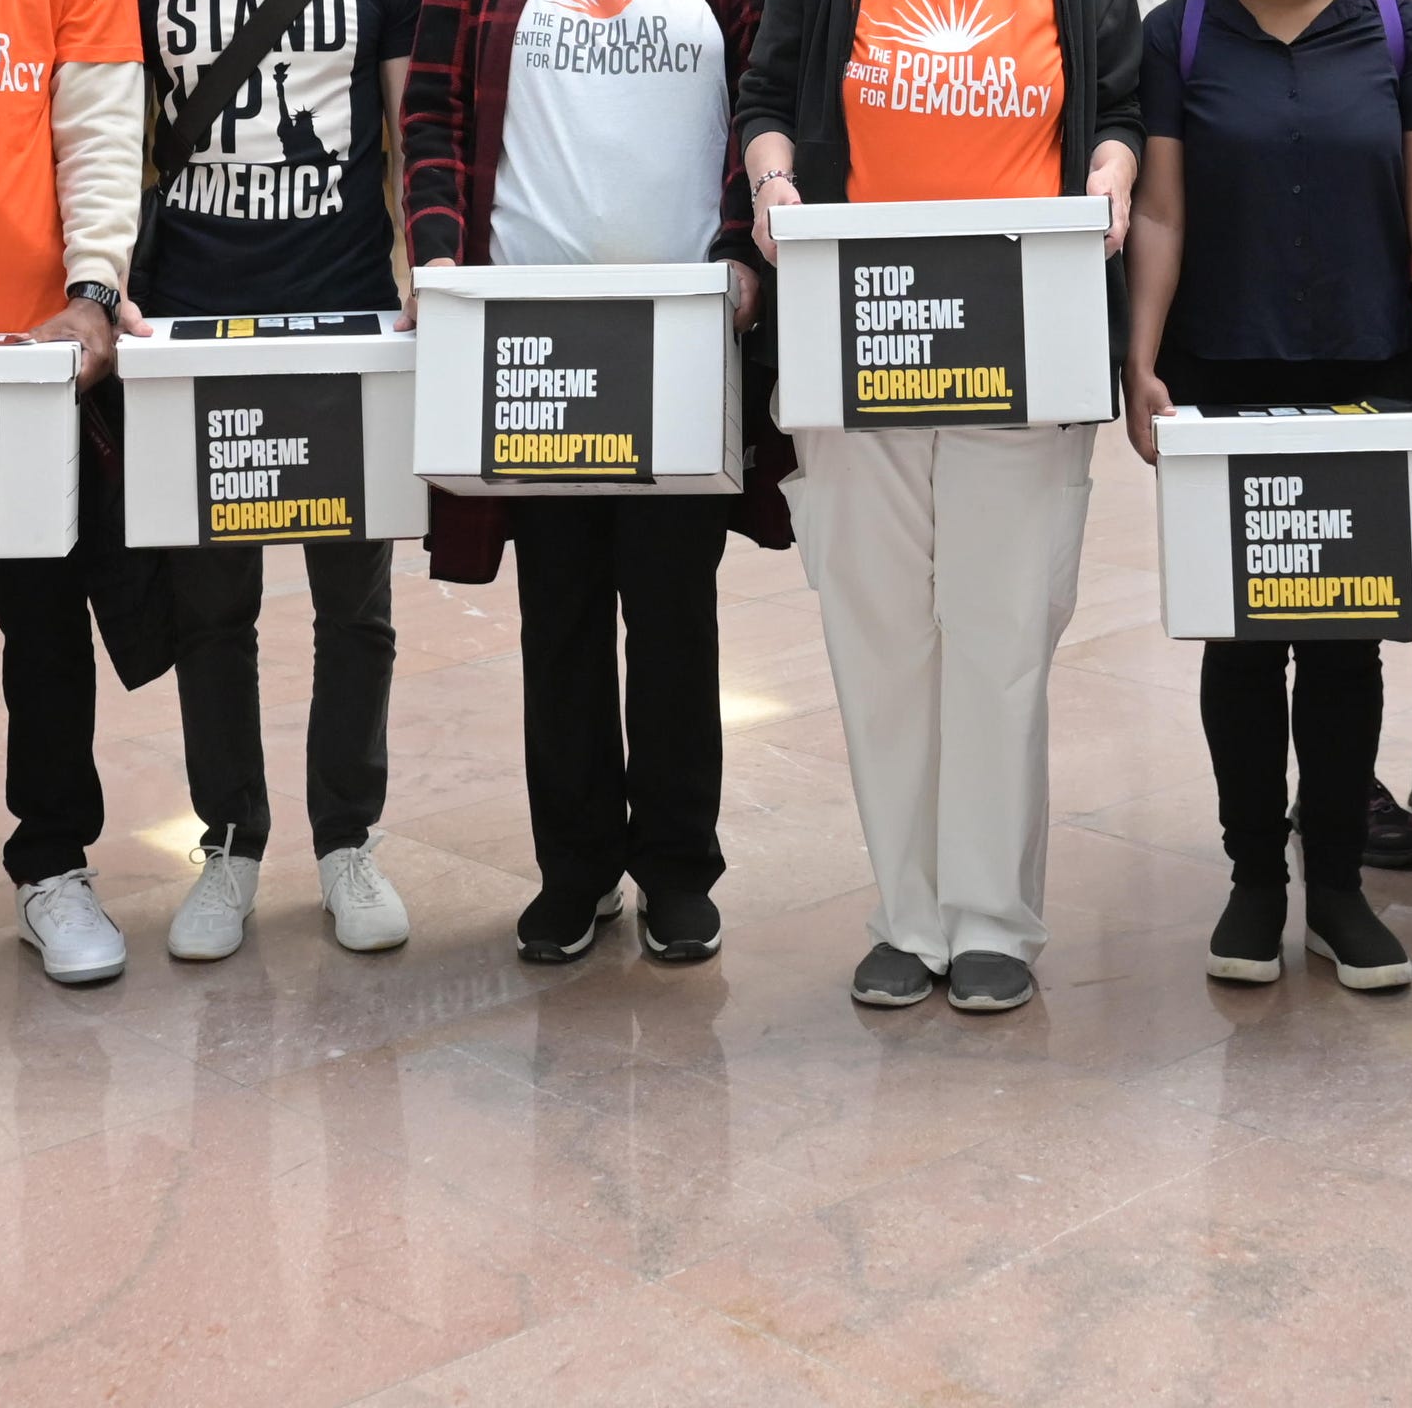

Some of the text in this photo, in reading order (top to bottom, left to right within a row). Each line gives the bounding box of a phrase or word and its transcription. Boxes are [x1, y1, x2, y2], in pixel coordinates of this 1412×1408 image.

[533, 11, 555, 28] THE
[558, 16, 668, 48] POPULAR
[514, 31, 551, 48] ENTER
[868, 44, 892, 64] THE
[526, 52, 549, 69] FOR
[554, 42, 703, 75] DEMOCRACY
[844, 61, 889, 85] CENTER
[895, 50, 1016, 88] POPULAR
[859, 88, 886, 108] FOR
[891, 78, 1052, 118] DEMOCRACY
[166, 163, 343, 220] AMERICA
[854, 265, 914, 297] STOP
[855, 298, 965, 332] SUPREME
[496, 337, 553, 365] STOP
[856, 333, 933, 367] COURT
[495, 369, 597, 398] SUPREME
[857, 366, 1013, 401] CORRUPTION.
[208, 408, 263, 438] STOP
[495, 401, 567, 430] COURT
[208, 437, 309, 469] SUPREME
[494, 433, 639, 463] CORRUPTION.
[210, 469, 281, 501] COURT
[1244, 476, 1303, 507] STOP
[211, 497, 352, 532] CORRUPTION.
[1245, 509, 1353, 541] SUPREME
[1246, 543, 1322, 574] COURT
[1247, 576, 1401, 608] CORRUPTION.
